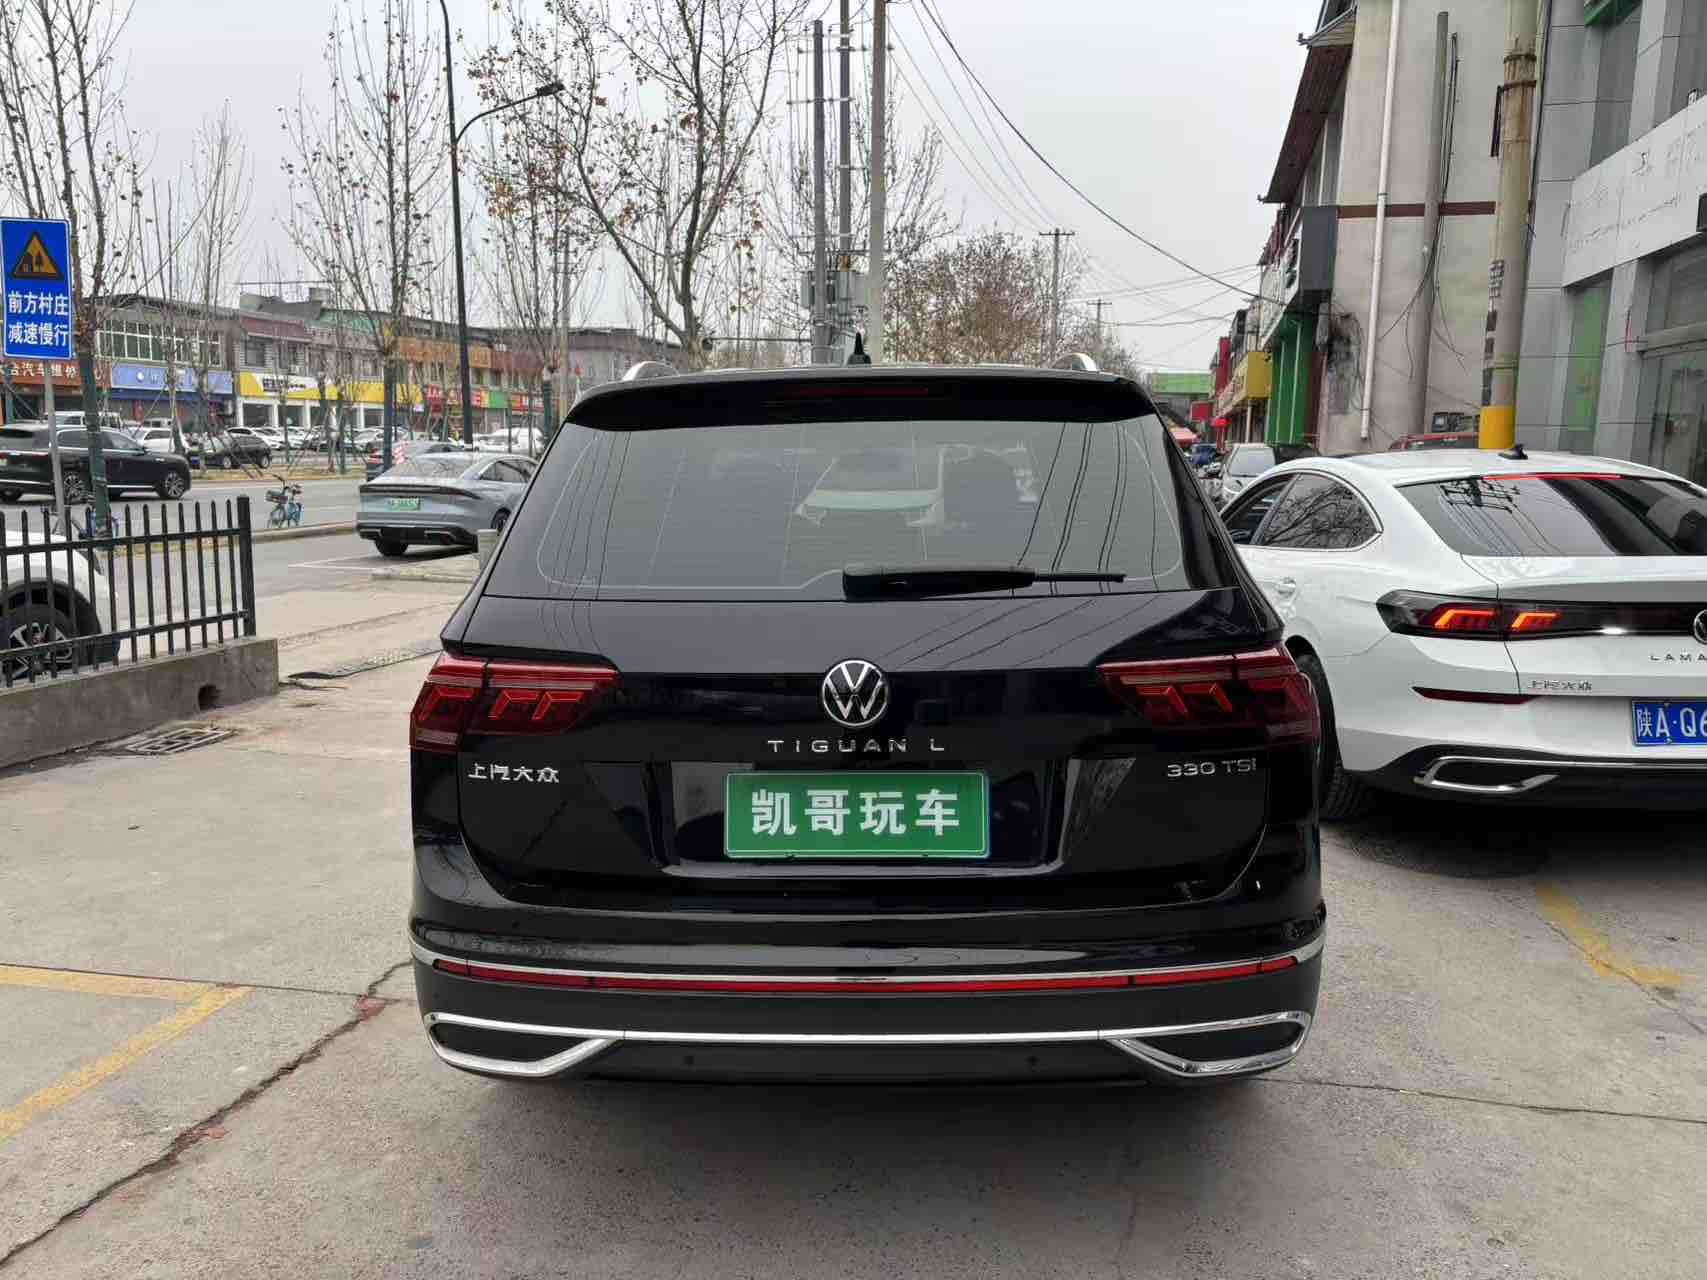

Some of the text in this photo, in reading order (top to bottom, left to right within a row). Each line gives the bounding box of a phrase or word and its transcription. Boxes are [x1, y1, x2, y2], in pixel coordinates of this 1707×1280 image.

[7, 290, 69, 316] 前方村庄
[8, 321, 69, 347] 减速慢行
[767, 738, 945, 753] TIGUAN L
[467, 762, 560, 783] 上汽大众
[1167, 761, 1216, 778] 330
[751, 788, 960, 836] 凯哥玩车
